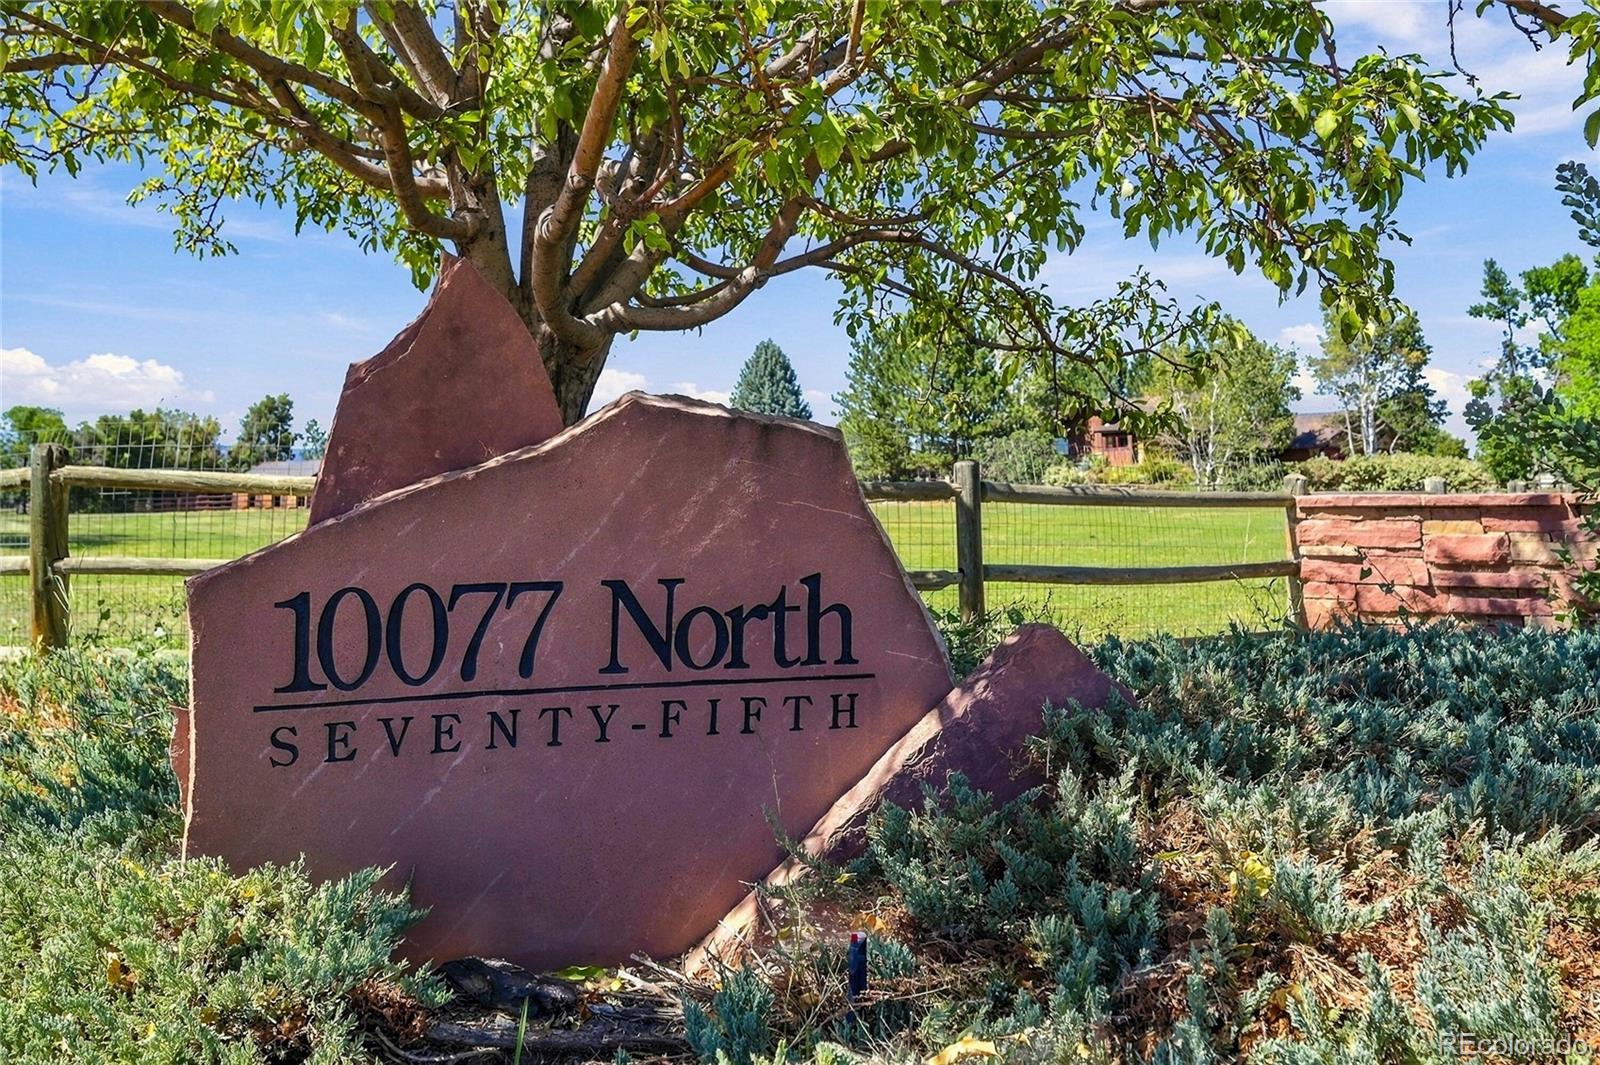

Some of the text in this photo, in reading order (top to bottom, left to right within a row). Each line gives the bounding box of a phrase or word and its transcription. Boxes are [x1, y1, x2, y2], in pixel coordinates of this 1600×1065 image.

[273, 571, 860, 694] 10077 North
[269, 692, 860, 769] SEVENTY-FIFTH
